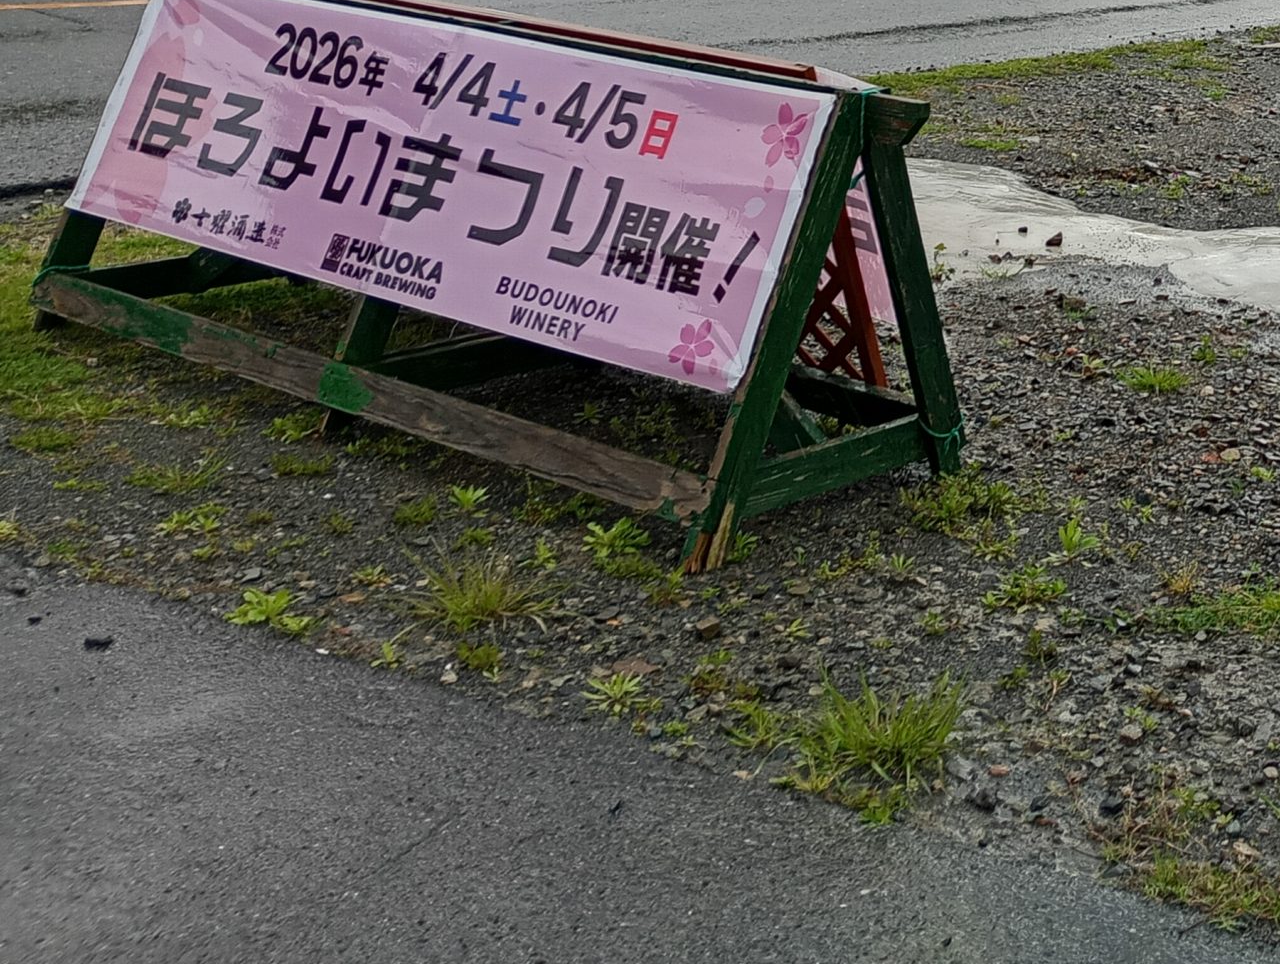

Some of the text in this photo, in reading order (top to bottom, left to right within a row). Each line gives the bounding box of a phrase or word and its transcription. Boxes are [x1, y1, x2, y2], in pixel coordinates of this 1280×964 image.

[264, 22, 390, 96] 2026年
[339, 261, 438, 300] CRAFT BREWING
[347, 237, 443, 284] FUKUOKA
[495, 276, 619, 325] BUDOUNOKI
[509, 304, 586, 343] WINERY
